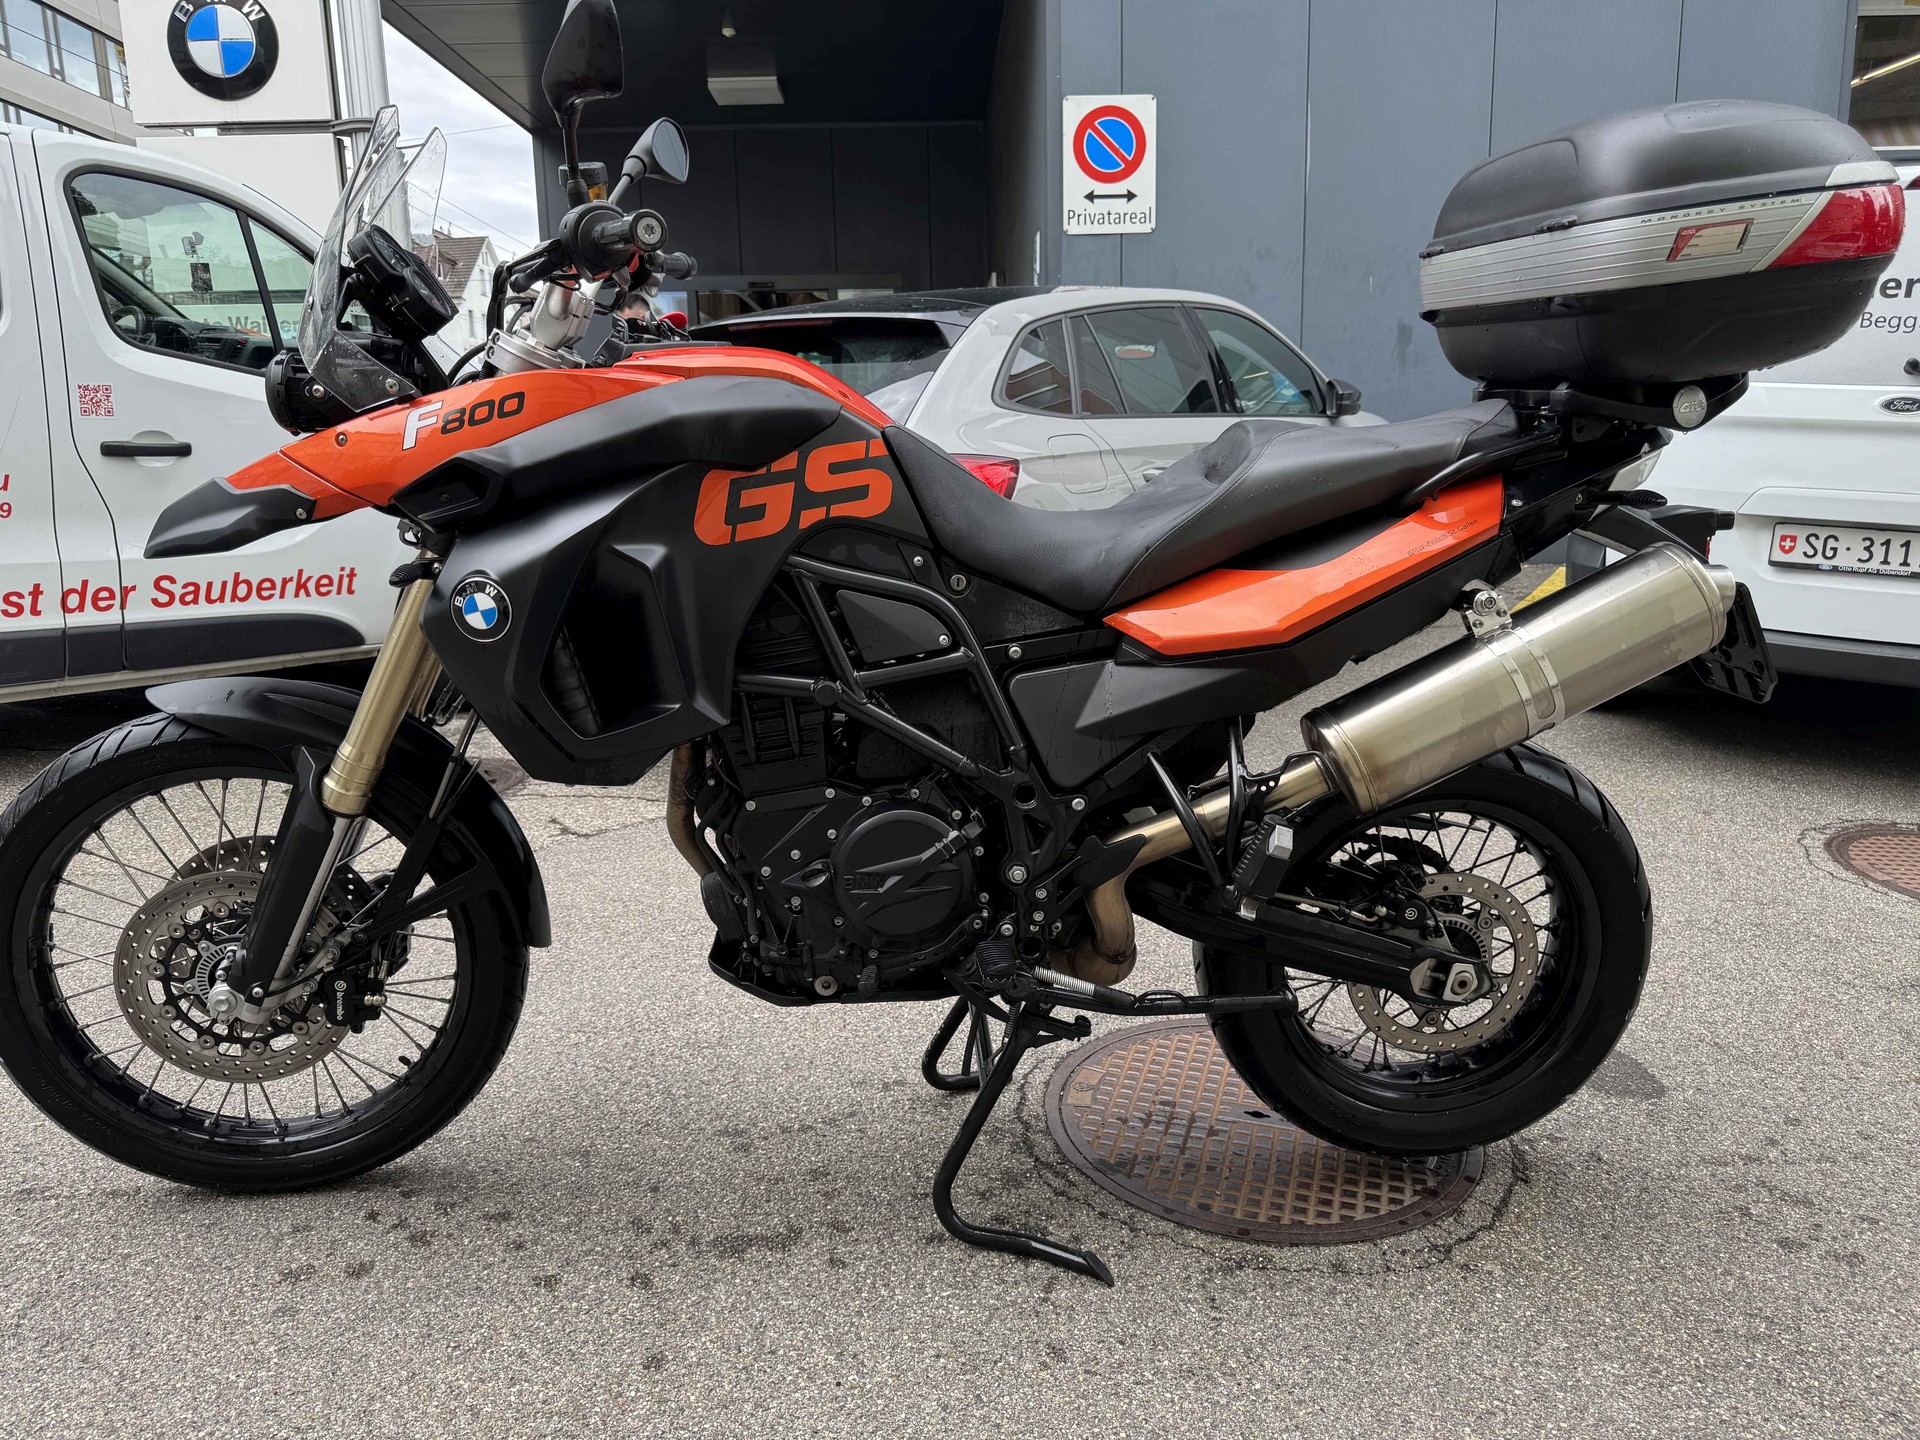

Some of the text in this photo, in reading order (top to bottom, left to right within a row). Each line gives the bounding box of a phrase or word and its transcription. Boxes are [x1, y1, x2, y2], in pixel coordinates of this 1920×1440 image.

[174, 0, 266, 23] BW
[1067, 206, 1152, 226] Privatareal
[1640, 199, 1801, 225] MONOKEY SYSTEM
[1859, 311, 1920, 334] Begg
[1890, 400, 1920, 411] Ford
[693, 438, 893, 546] GS
[1802, 532, 1920, 568] SG 311
[60, 579, 136, 614] der
[150, 566, 357, 609] Sauberkeit
[454, 582, 498, 608] BMW
[336, 991, 345, 1021] brembo
